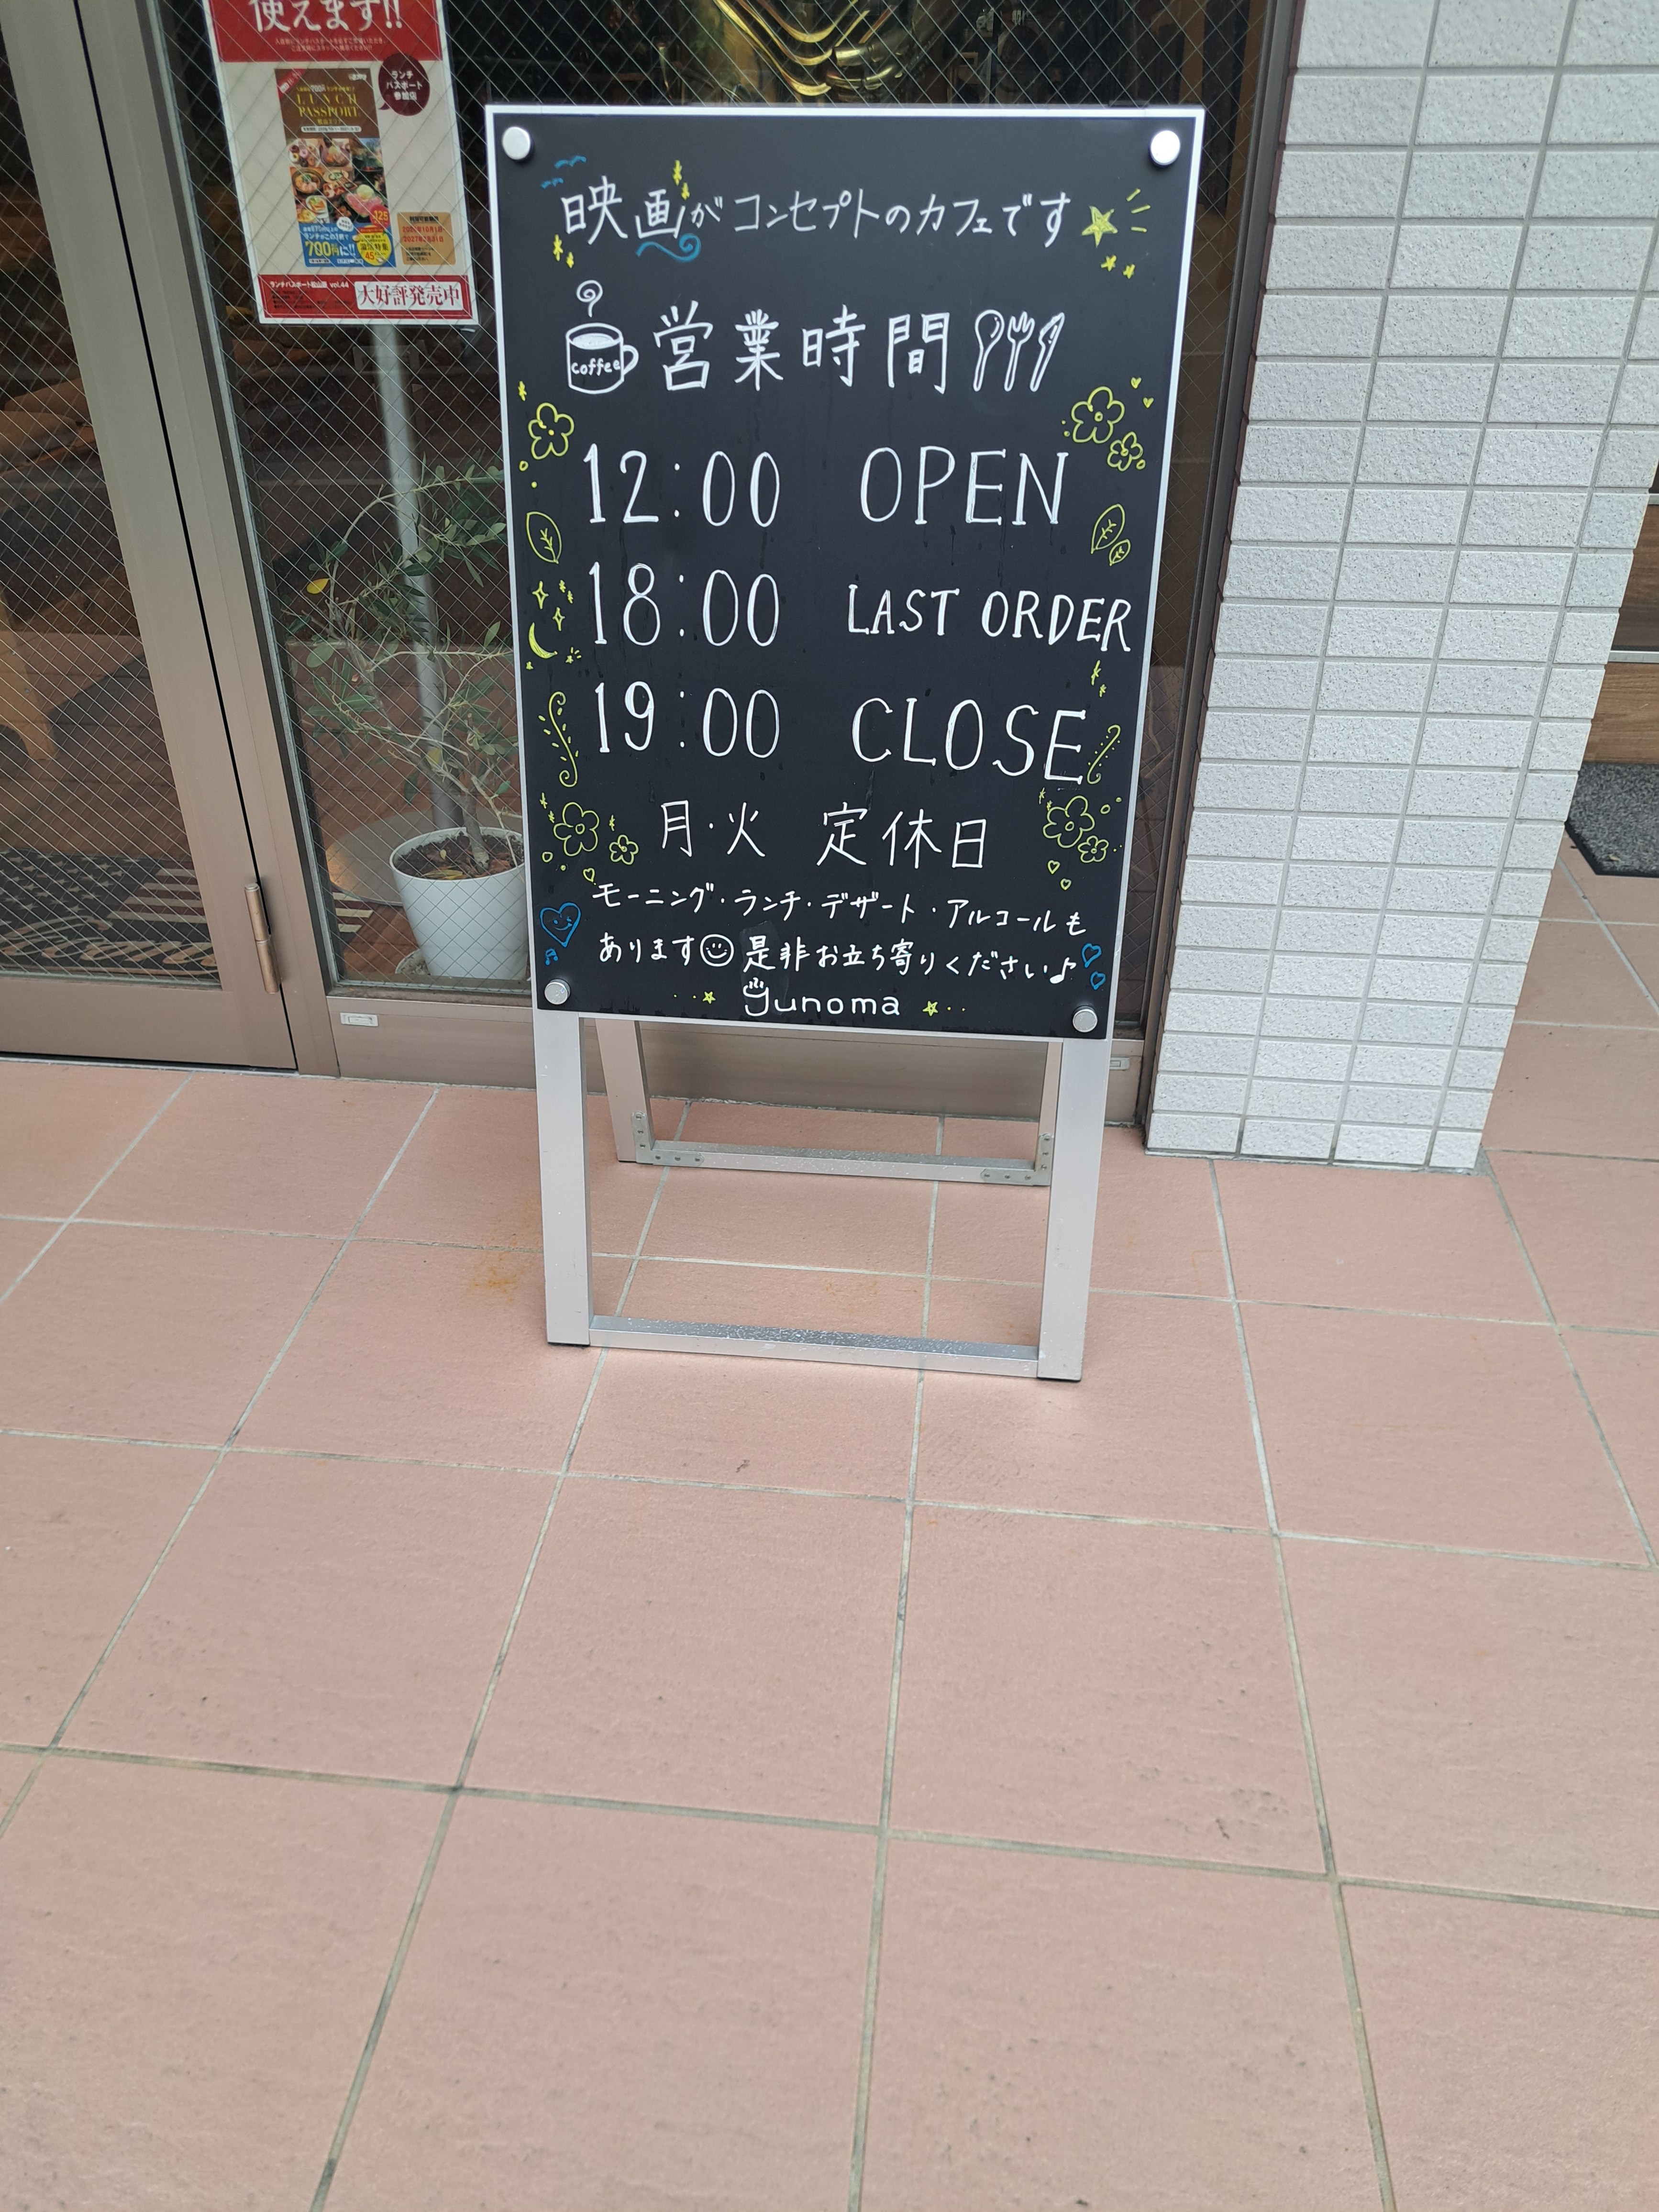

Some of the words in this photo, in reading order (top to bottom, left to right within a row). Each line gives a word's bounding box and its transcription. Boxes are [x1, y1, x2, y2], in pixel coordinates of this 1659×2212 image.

[299, 106, 359, 117] PASSPORT
[374, 210, 388, 221] 125
[560, 175, 1072, 248] 映画がコンセプトのカフェです
[365, 252, 375, 260] 45
[360, 285, 460, 306] 大好評発売中
[571, 358, 620, 376] coffee
[653, 299, 951, 395] 営業時間
[583, 442, 780, 528] 12:00
[860, 445, 1070, 526] OPEN
[588, 561, 779, 647] 18:00
[848, 583, 961, 636] LAST
[981, 590, 1132, 653] ORDER
[594, 681, 780, 759] 19:00
[852, 697, 1086, 785] CLOSE
[816, 801, 987, 870] 定休日
[599, 931, 695, 966] あります
